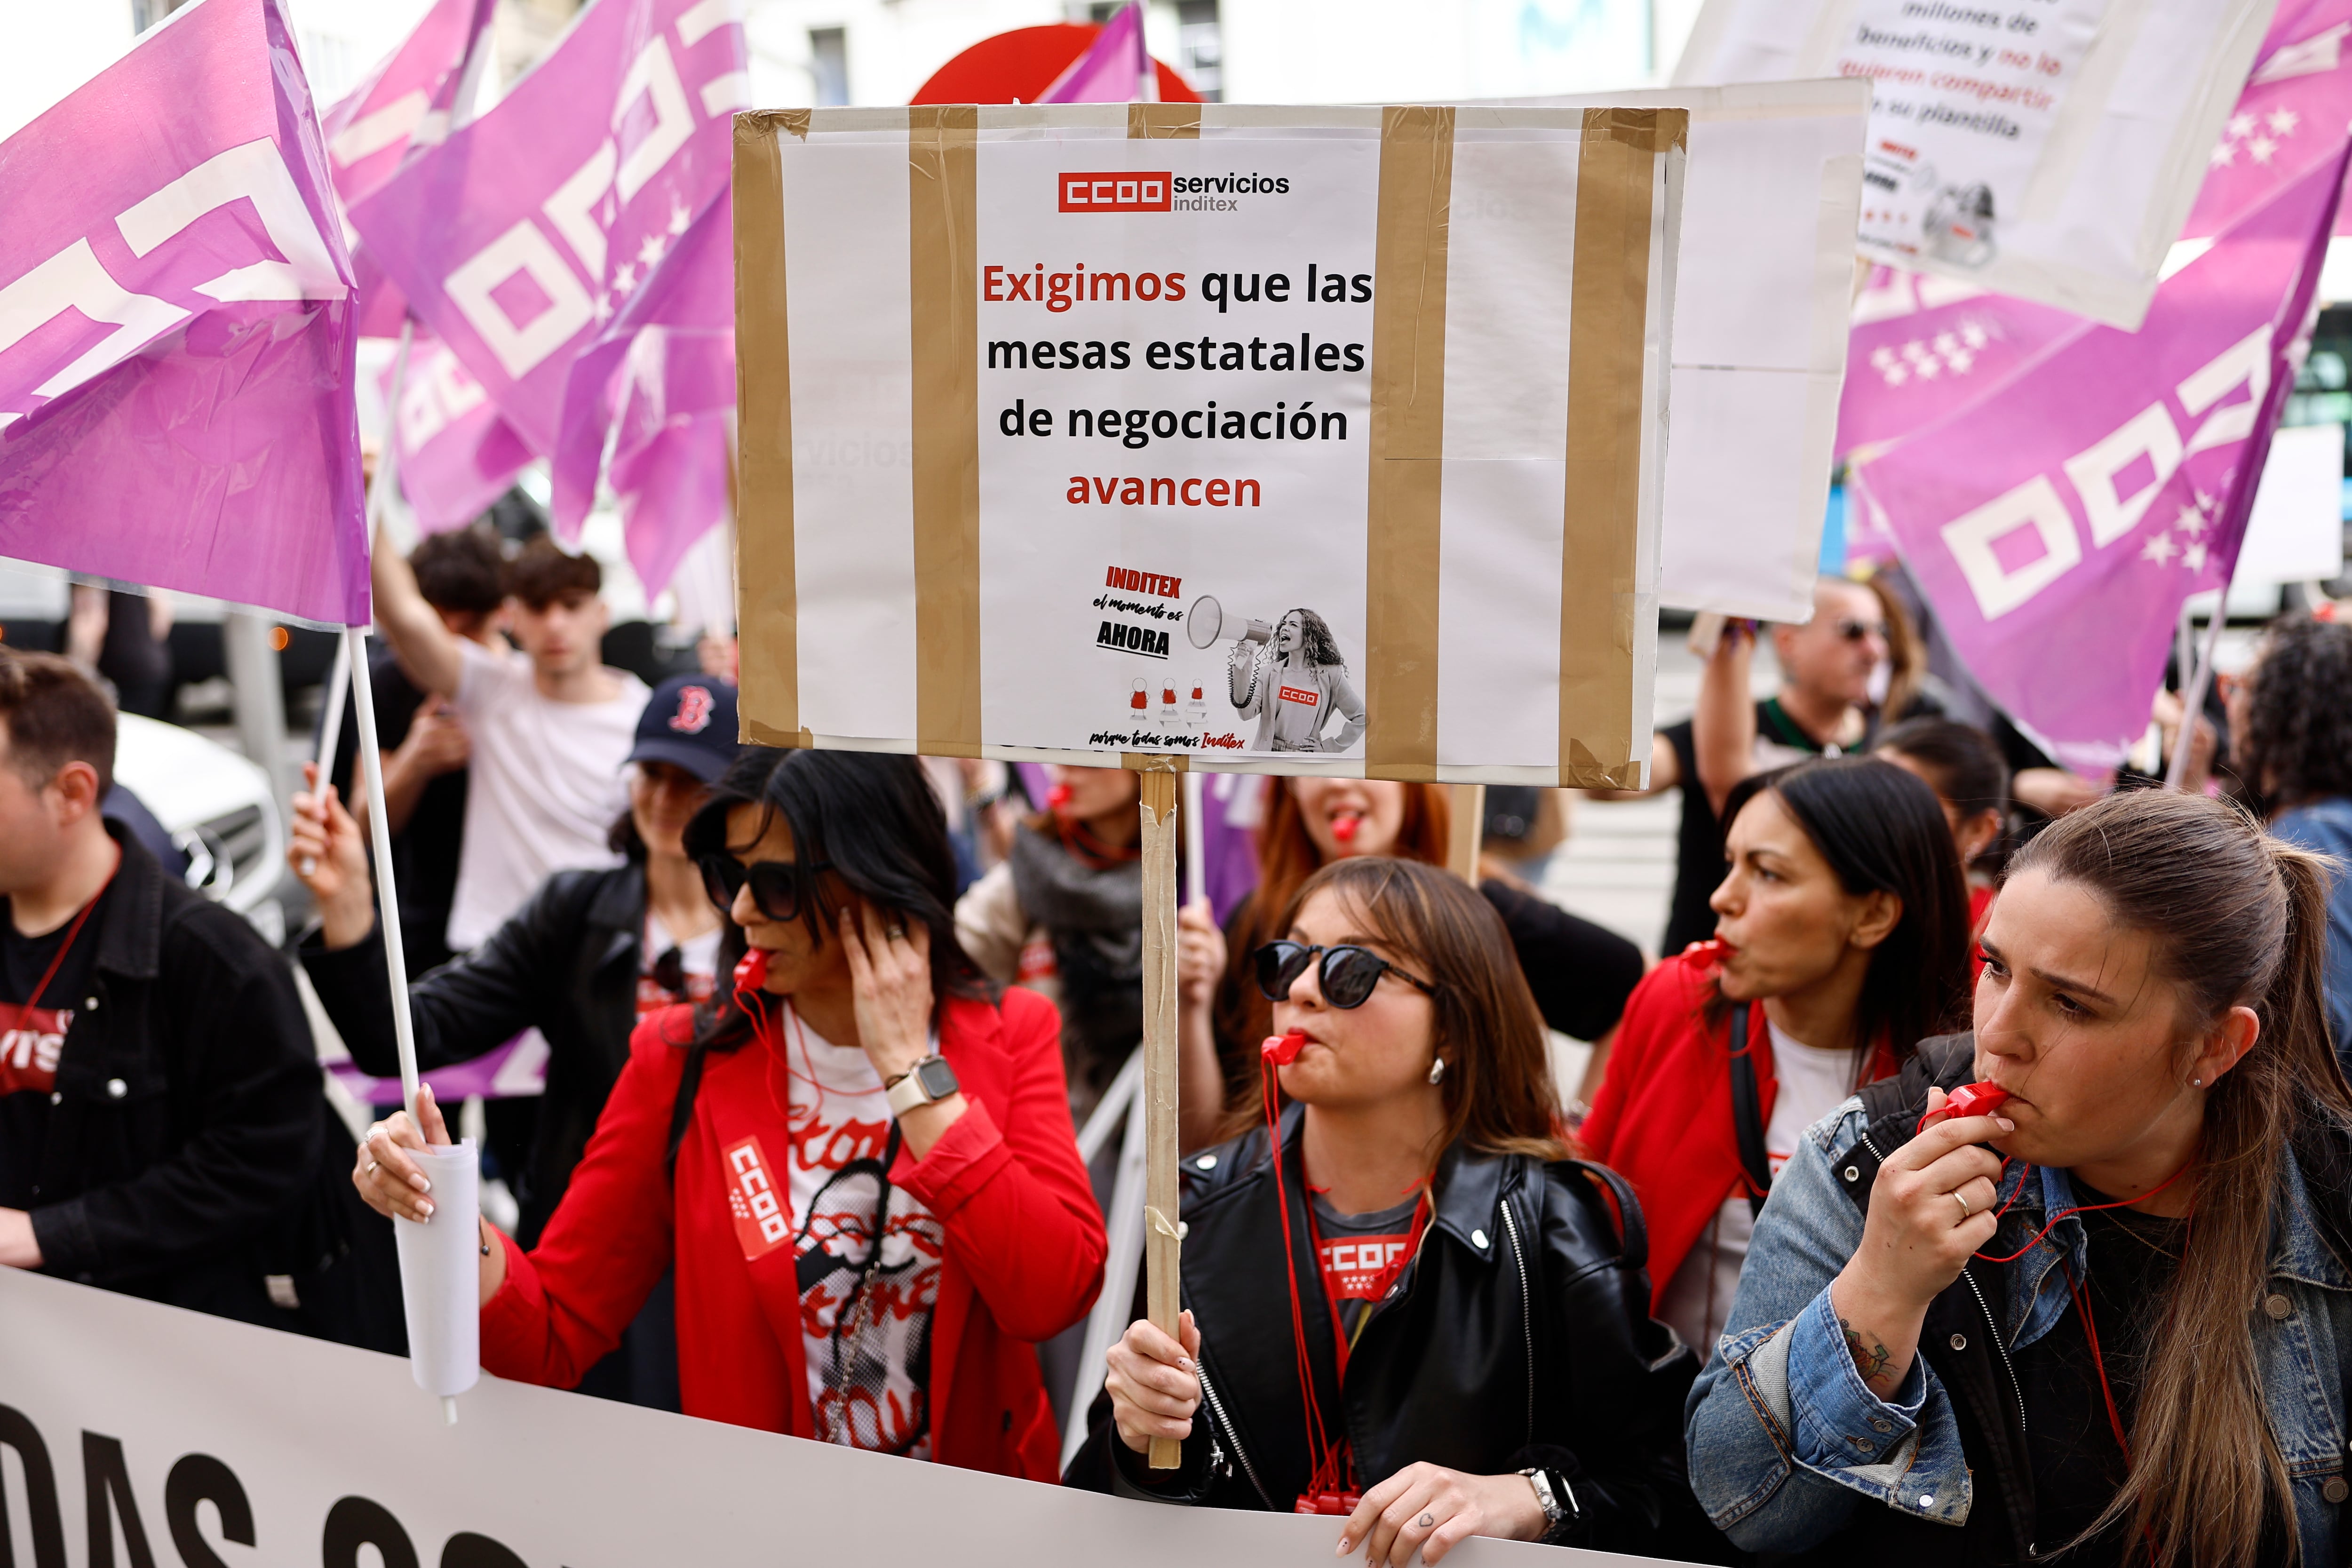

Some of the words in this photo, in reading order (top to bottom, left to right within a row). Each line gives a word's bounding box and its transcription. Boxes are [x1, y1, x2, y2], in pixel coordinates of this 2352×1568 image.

[1067, 181, 1163, 204] CCOO
[1173, 172, 1289, 194] servicios
[1174, 195, 1238, 212] inditex
[984, 263, 1186, 313] Exigimos
[1202, 273, 1290, 313] que
[1308, 263, 1373, 303] las
[988, 339, 1131, 370] mesas
[1146, 332, 1365, 373] estatales
[1000, 398, 1053, 437] de
[1069, 400, 1347, 449] negociación
[1067, 475, 1261, 507] avancen
[1105, 565, 1182, 599] INDITEX
[1093, 593, 1108, 610] el
[1108, 598, 1167, 619] momento
[1167, 611, 1184, 621] es
[1096, 621, 1169, 656] AHORA
[667, 685, 715, 735] B
[1281, 689, 1316, 703] CCOO
[1089, 730, 1131, 746] porque
[1131, 729, 1162, 747] todas
[1163, 735, 1200, 748] somos
[1200, 732, 1245, 749] Inditex
[730, 1144, 790, 1244] CCOO
